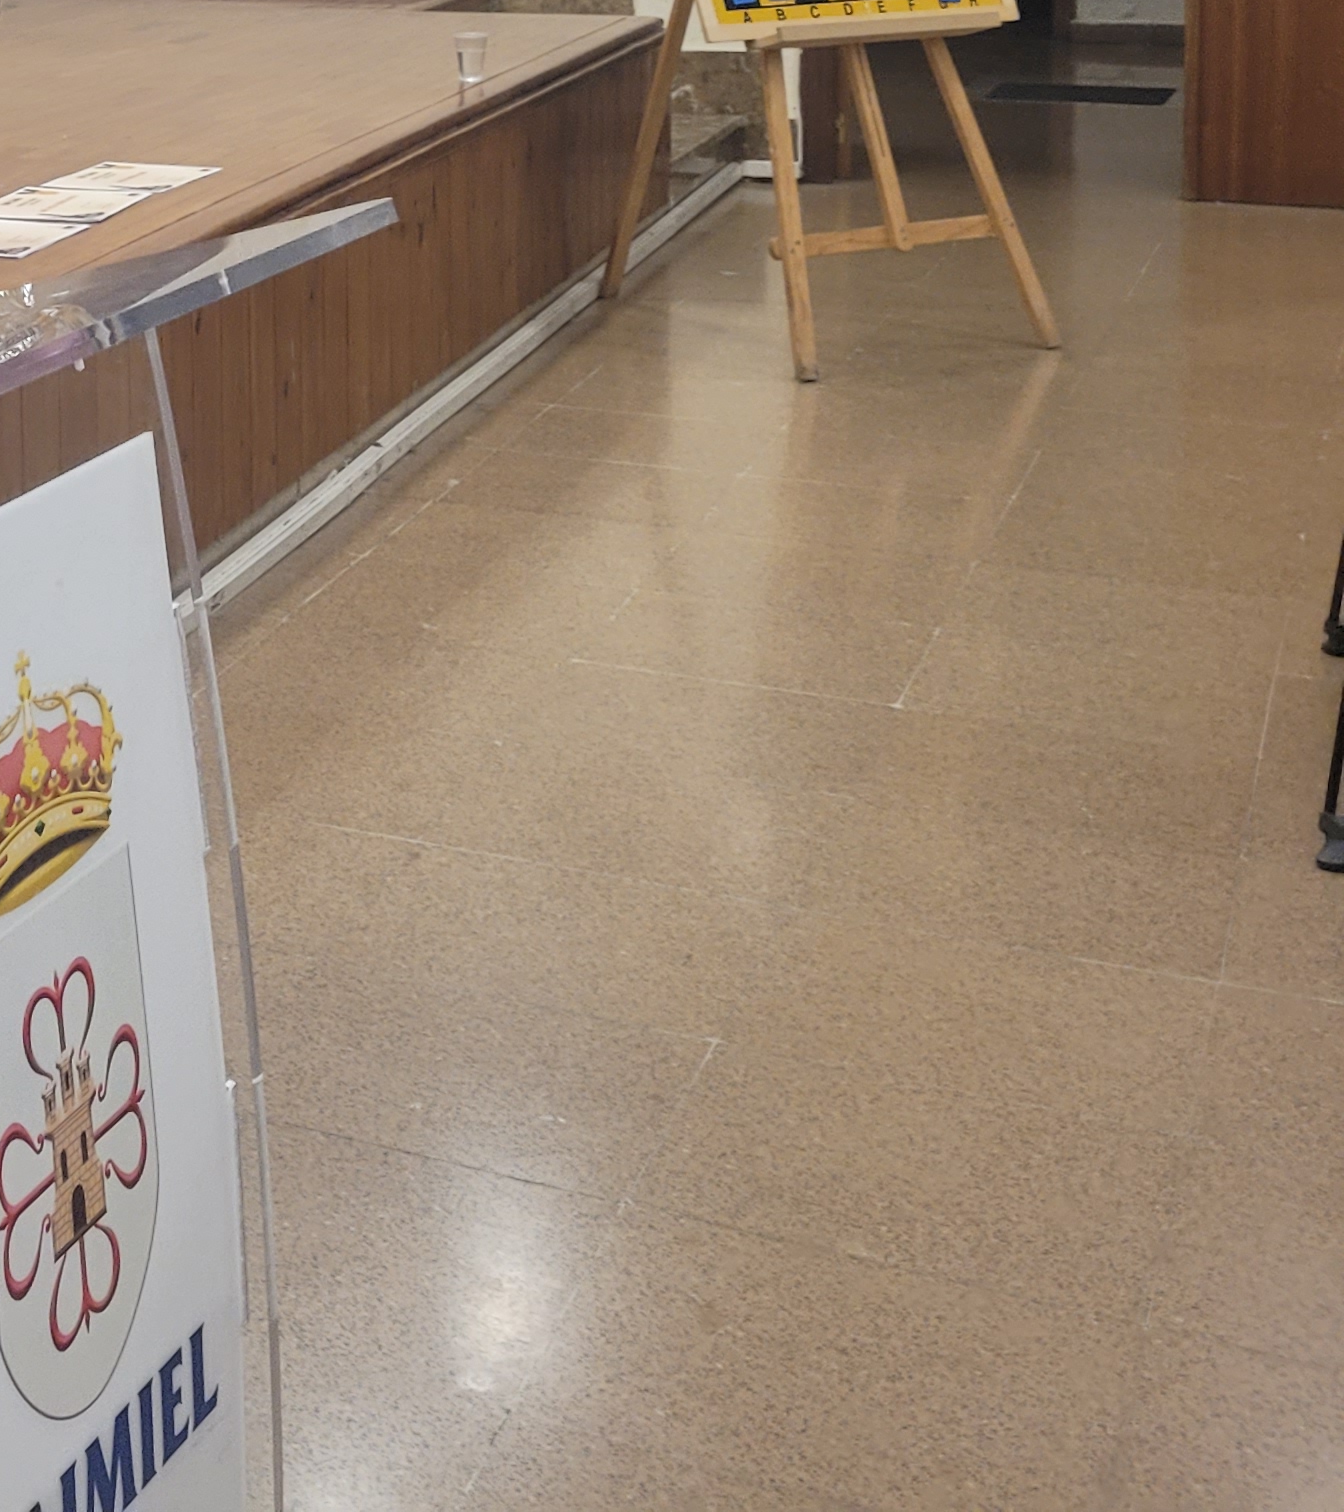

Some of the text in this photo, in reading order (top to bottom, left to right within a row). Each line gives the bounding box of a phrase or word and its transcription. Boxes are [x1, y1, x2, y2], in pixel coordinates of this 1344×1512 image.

[743, 11, 753, 24] A
[776, 8, 787, 21] B
[810, 5, 820, 18] C
[843, 3, 854, 16] D
[877, 0, 887, 14] E
[29, 1322, 219, 1512] IMIEL
